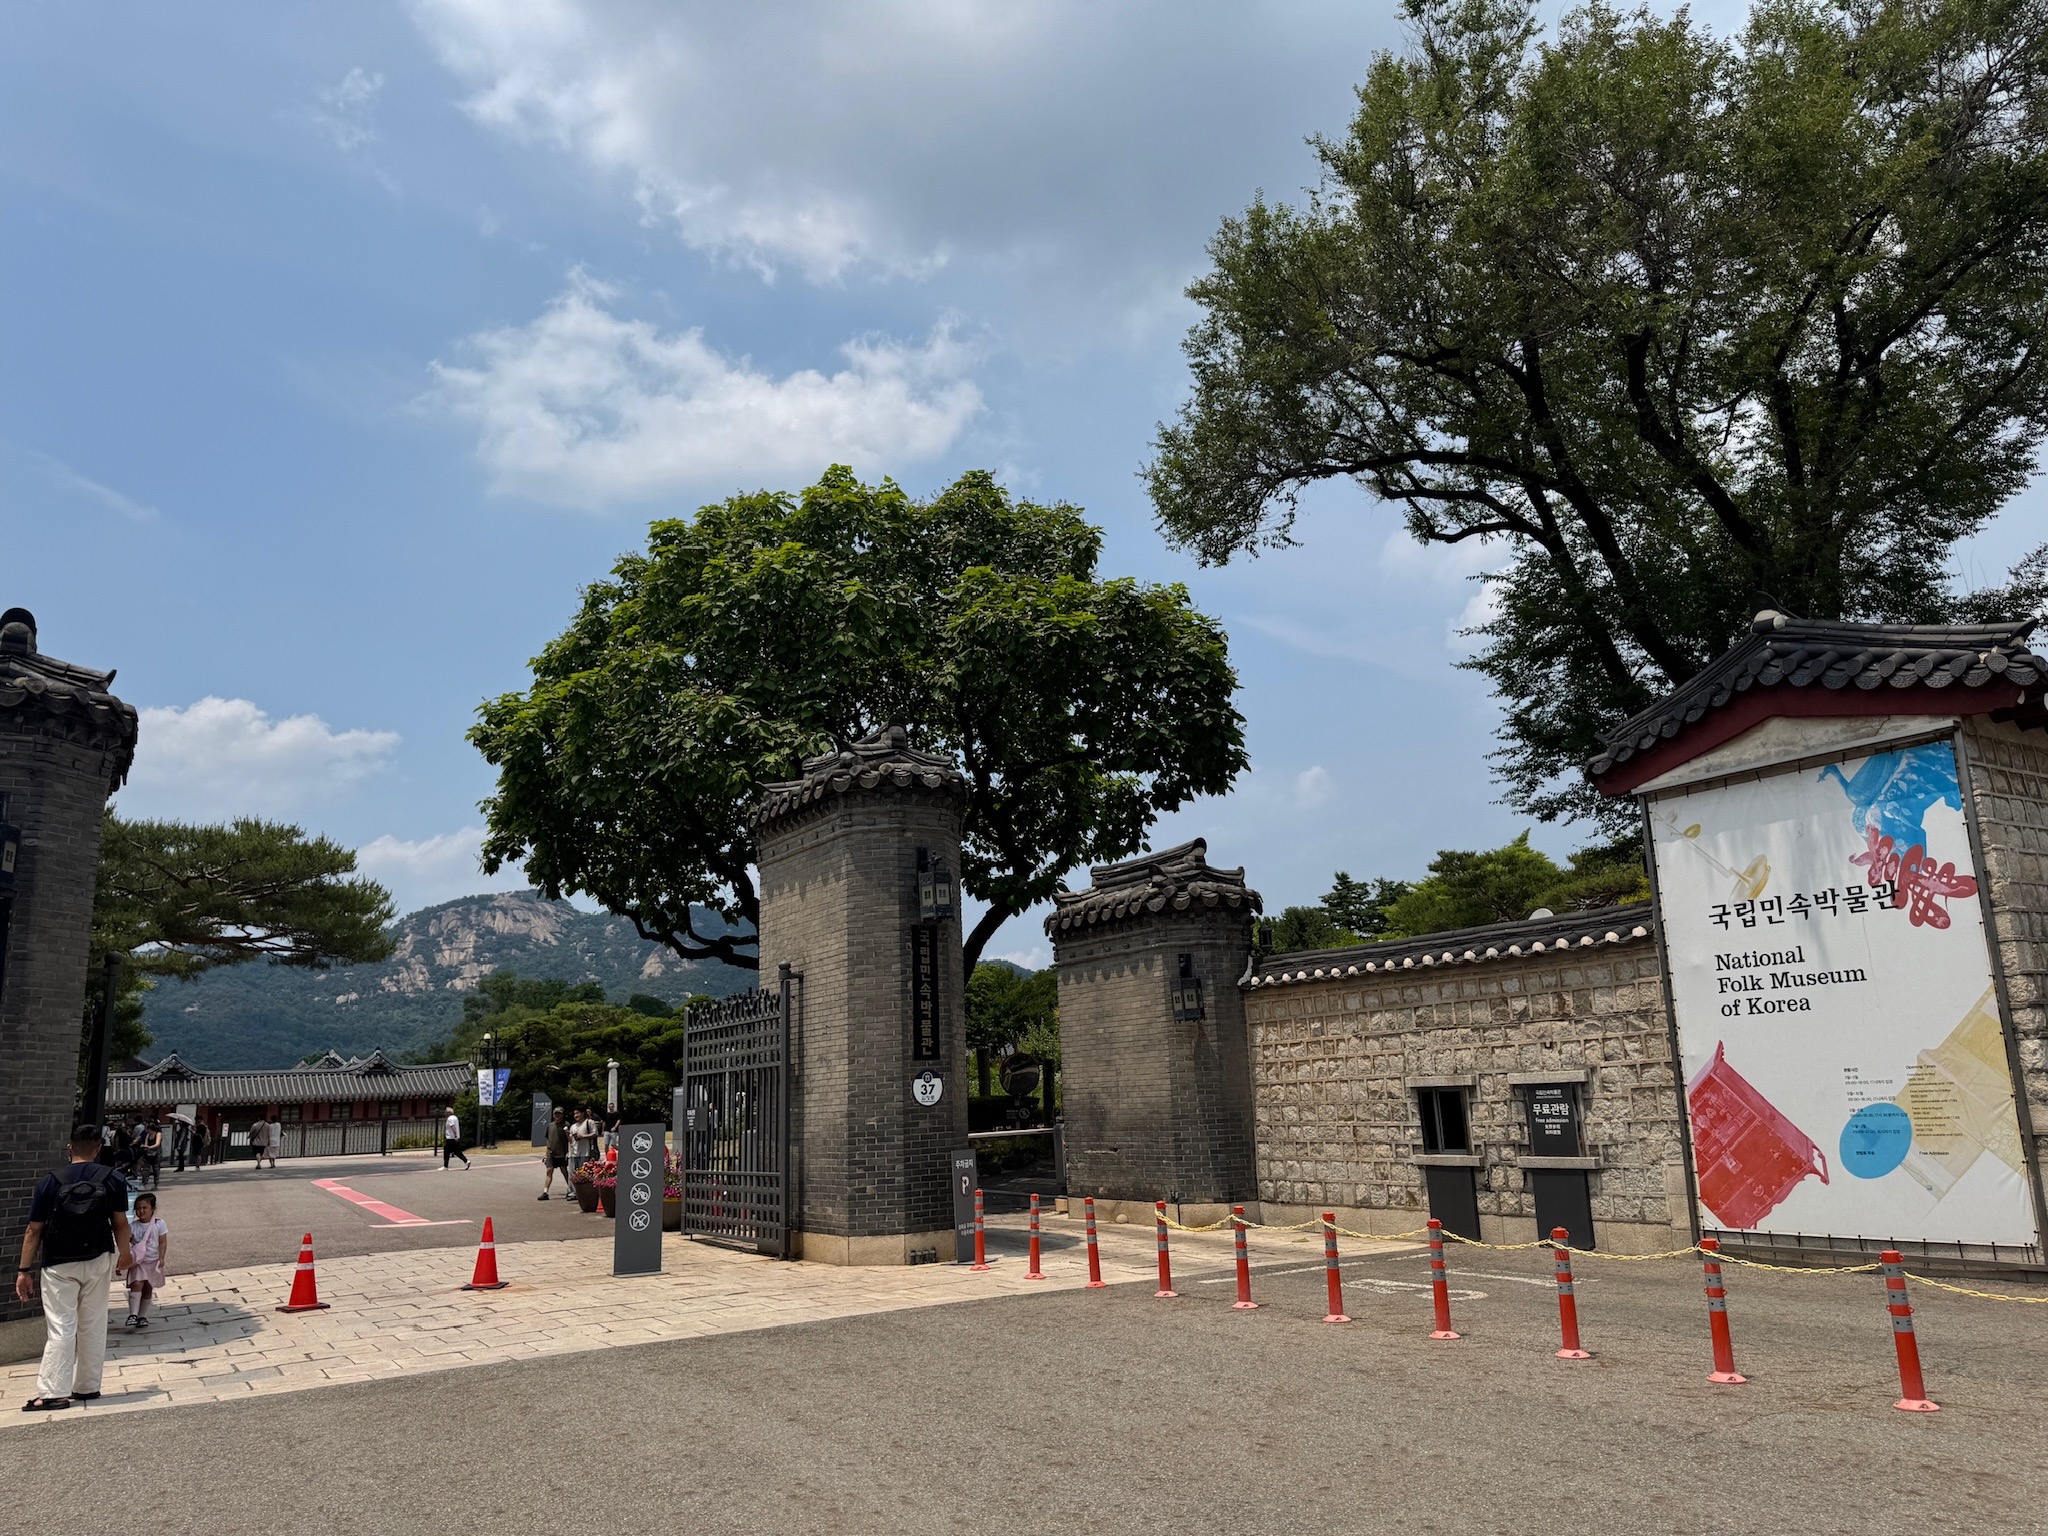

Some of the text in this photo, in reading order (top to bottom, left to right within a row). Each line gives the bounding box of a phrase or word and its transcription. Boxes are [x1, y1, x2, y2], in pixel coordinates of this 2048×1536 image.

[1709, 880, 1899, 930] 국립민속박물관
[1715, 946, 1805, 971] National
[1717, 967, 1867, 993] Folk Museum
[920, 929, 933, 1056] 국립민속박물관
[1721, 997, 1811, 1016] of Korea
[921, 1084, 936, 1095] 37
[1533, 1103, 1569, 1115] 무료관람
[955, 1159, 973, 1169] 주차금지
